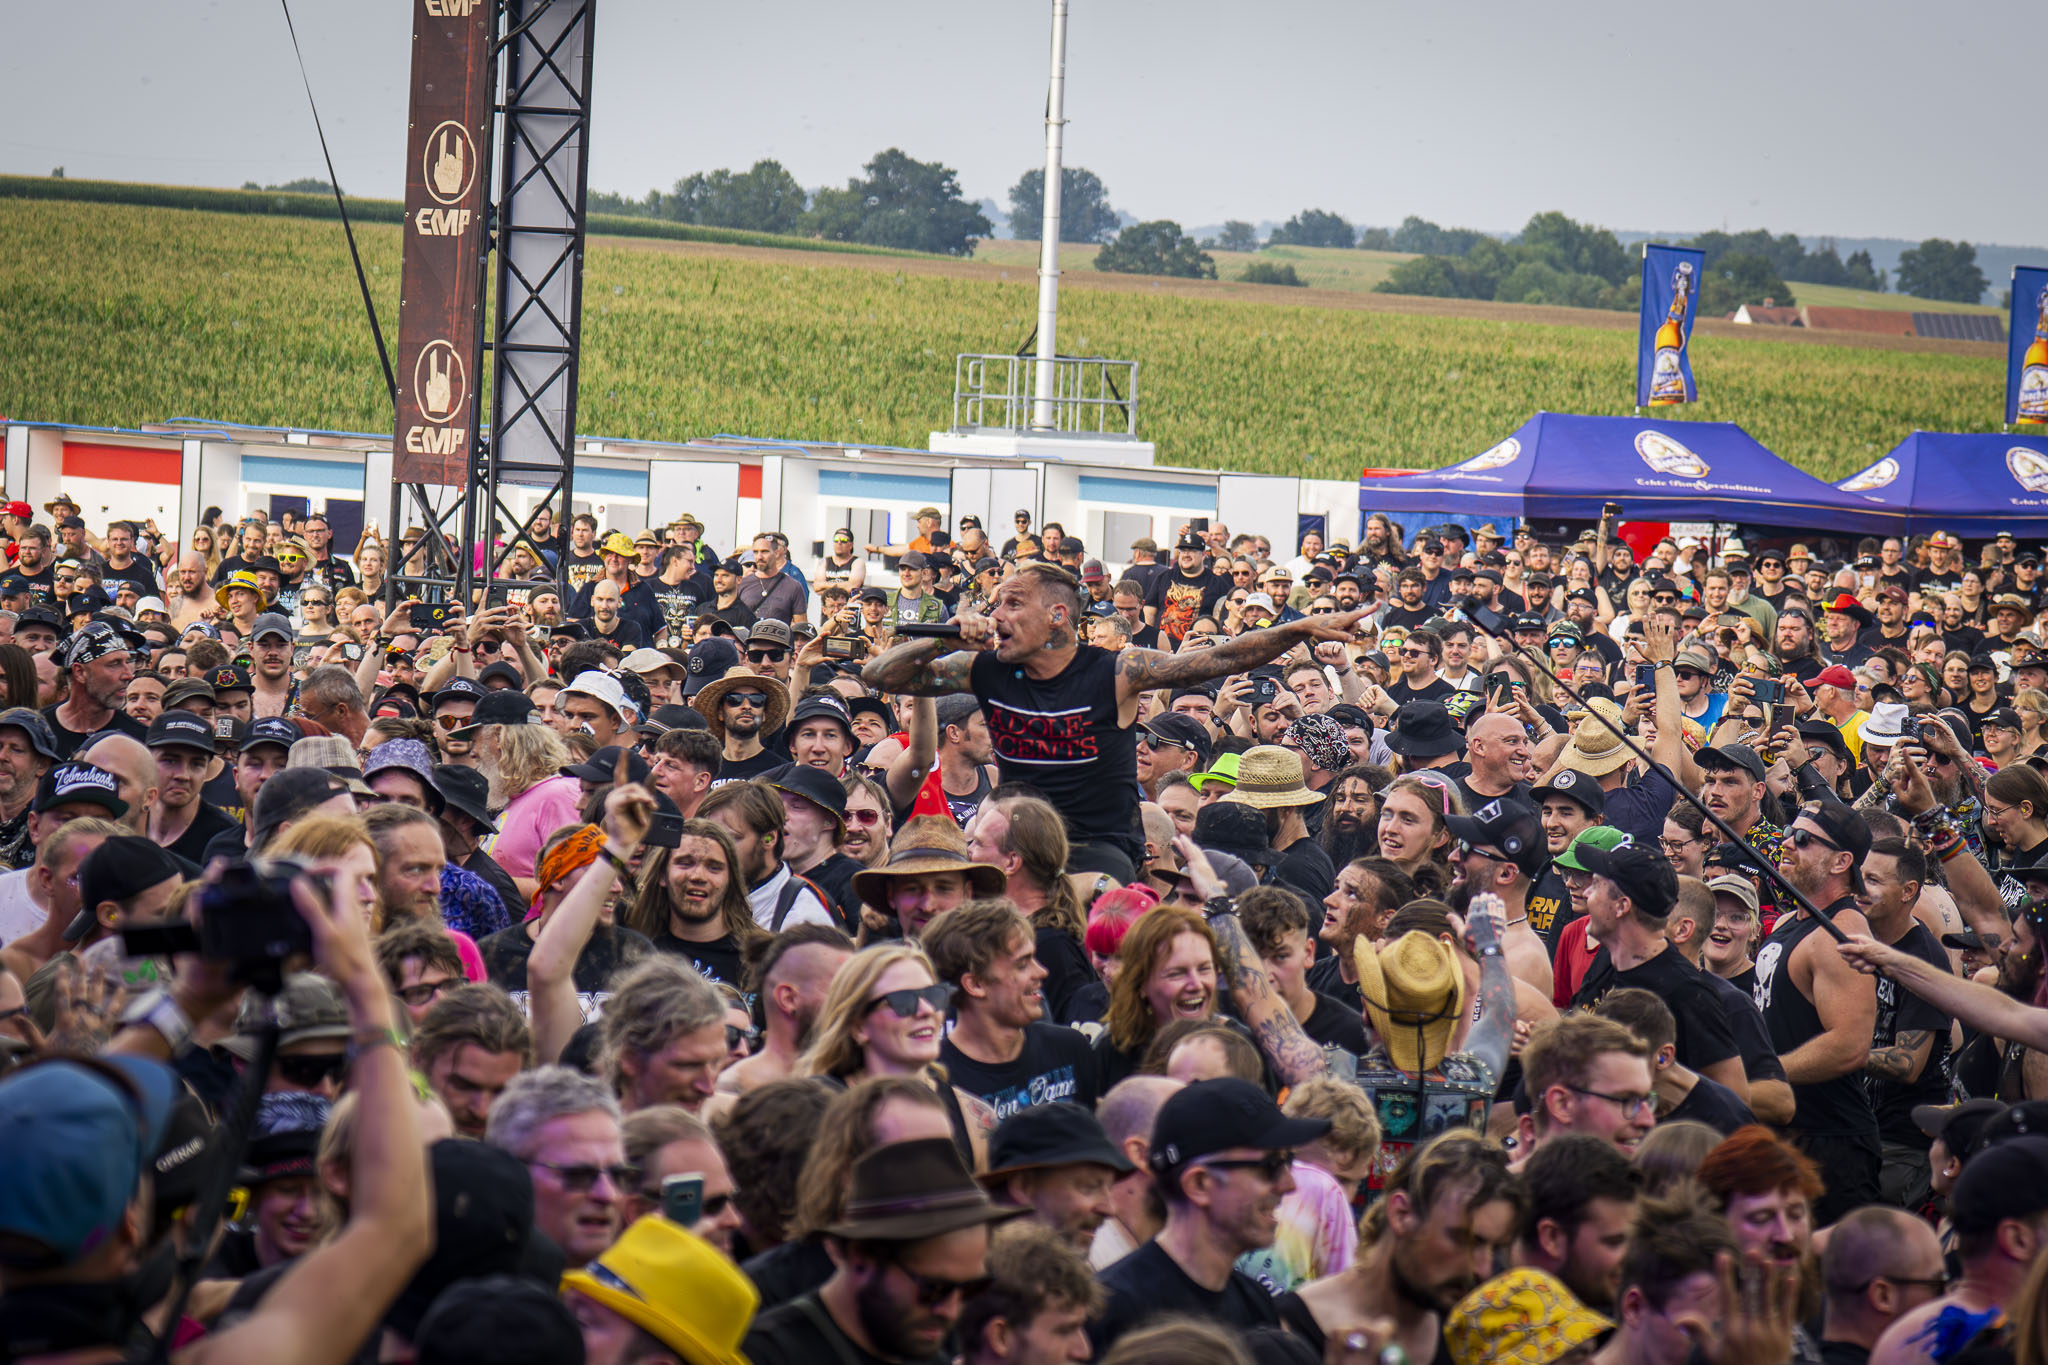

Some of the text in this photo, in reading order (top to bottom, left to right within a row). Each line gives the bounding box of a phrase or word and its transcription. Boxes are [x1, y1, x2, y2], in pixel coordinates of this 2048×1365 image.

[415, 208, 471, 236] EMP
[405, 426, 465, 455] EMP
[988, 708, 1094, 739] ADOLE-
[53, 764, 115, 793] Zebrahead
